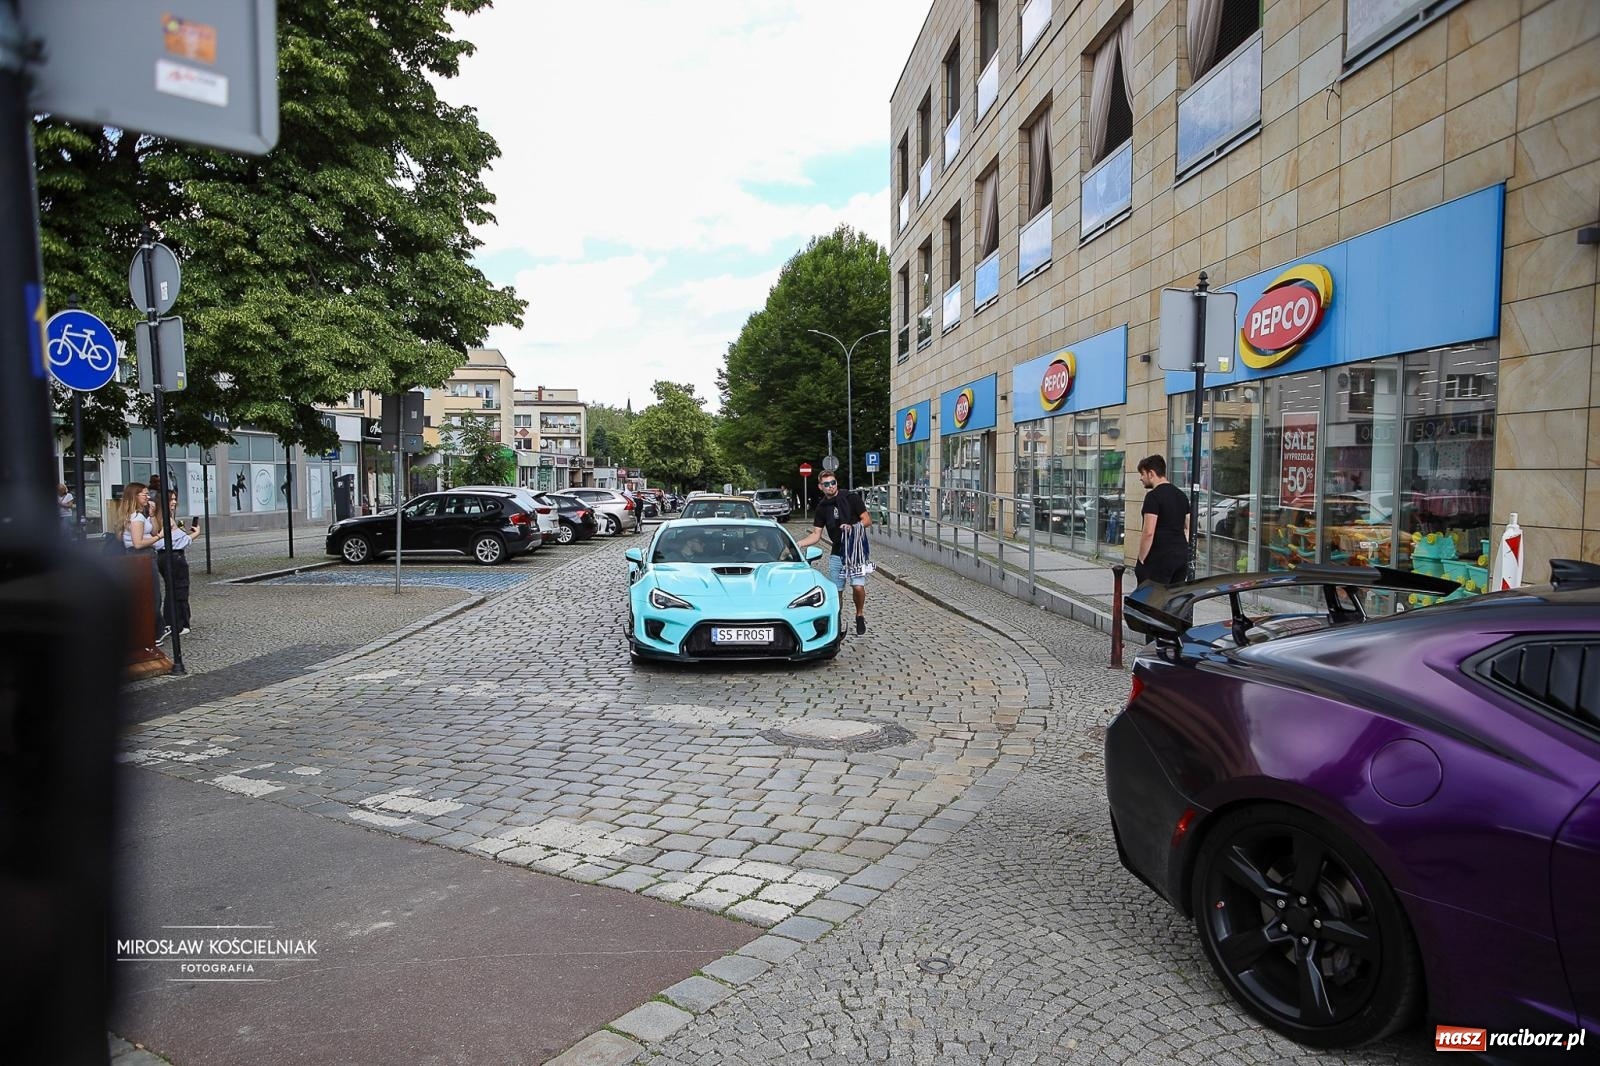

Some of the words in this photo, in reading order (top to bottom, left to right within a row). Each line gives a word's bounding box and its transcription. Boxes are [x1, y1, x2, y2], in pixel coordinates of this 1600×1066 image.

[1250, 297, 1310, 339] PEPCO
[1044, 371, 1066, 392] PEPCO
[1284, 431, 1314, 450] SALE
[1283, 466, 1314, 493] -50%
[719, 629, 733, 641] S5
[736, 629, 772, 641] FROST
